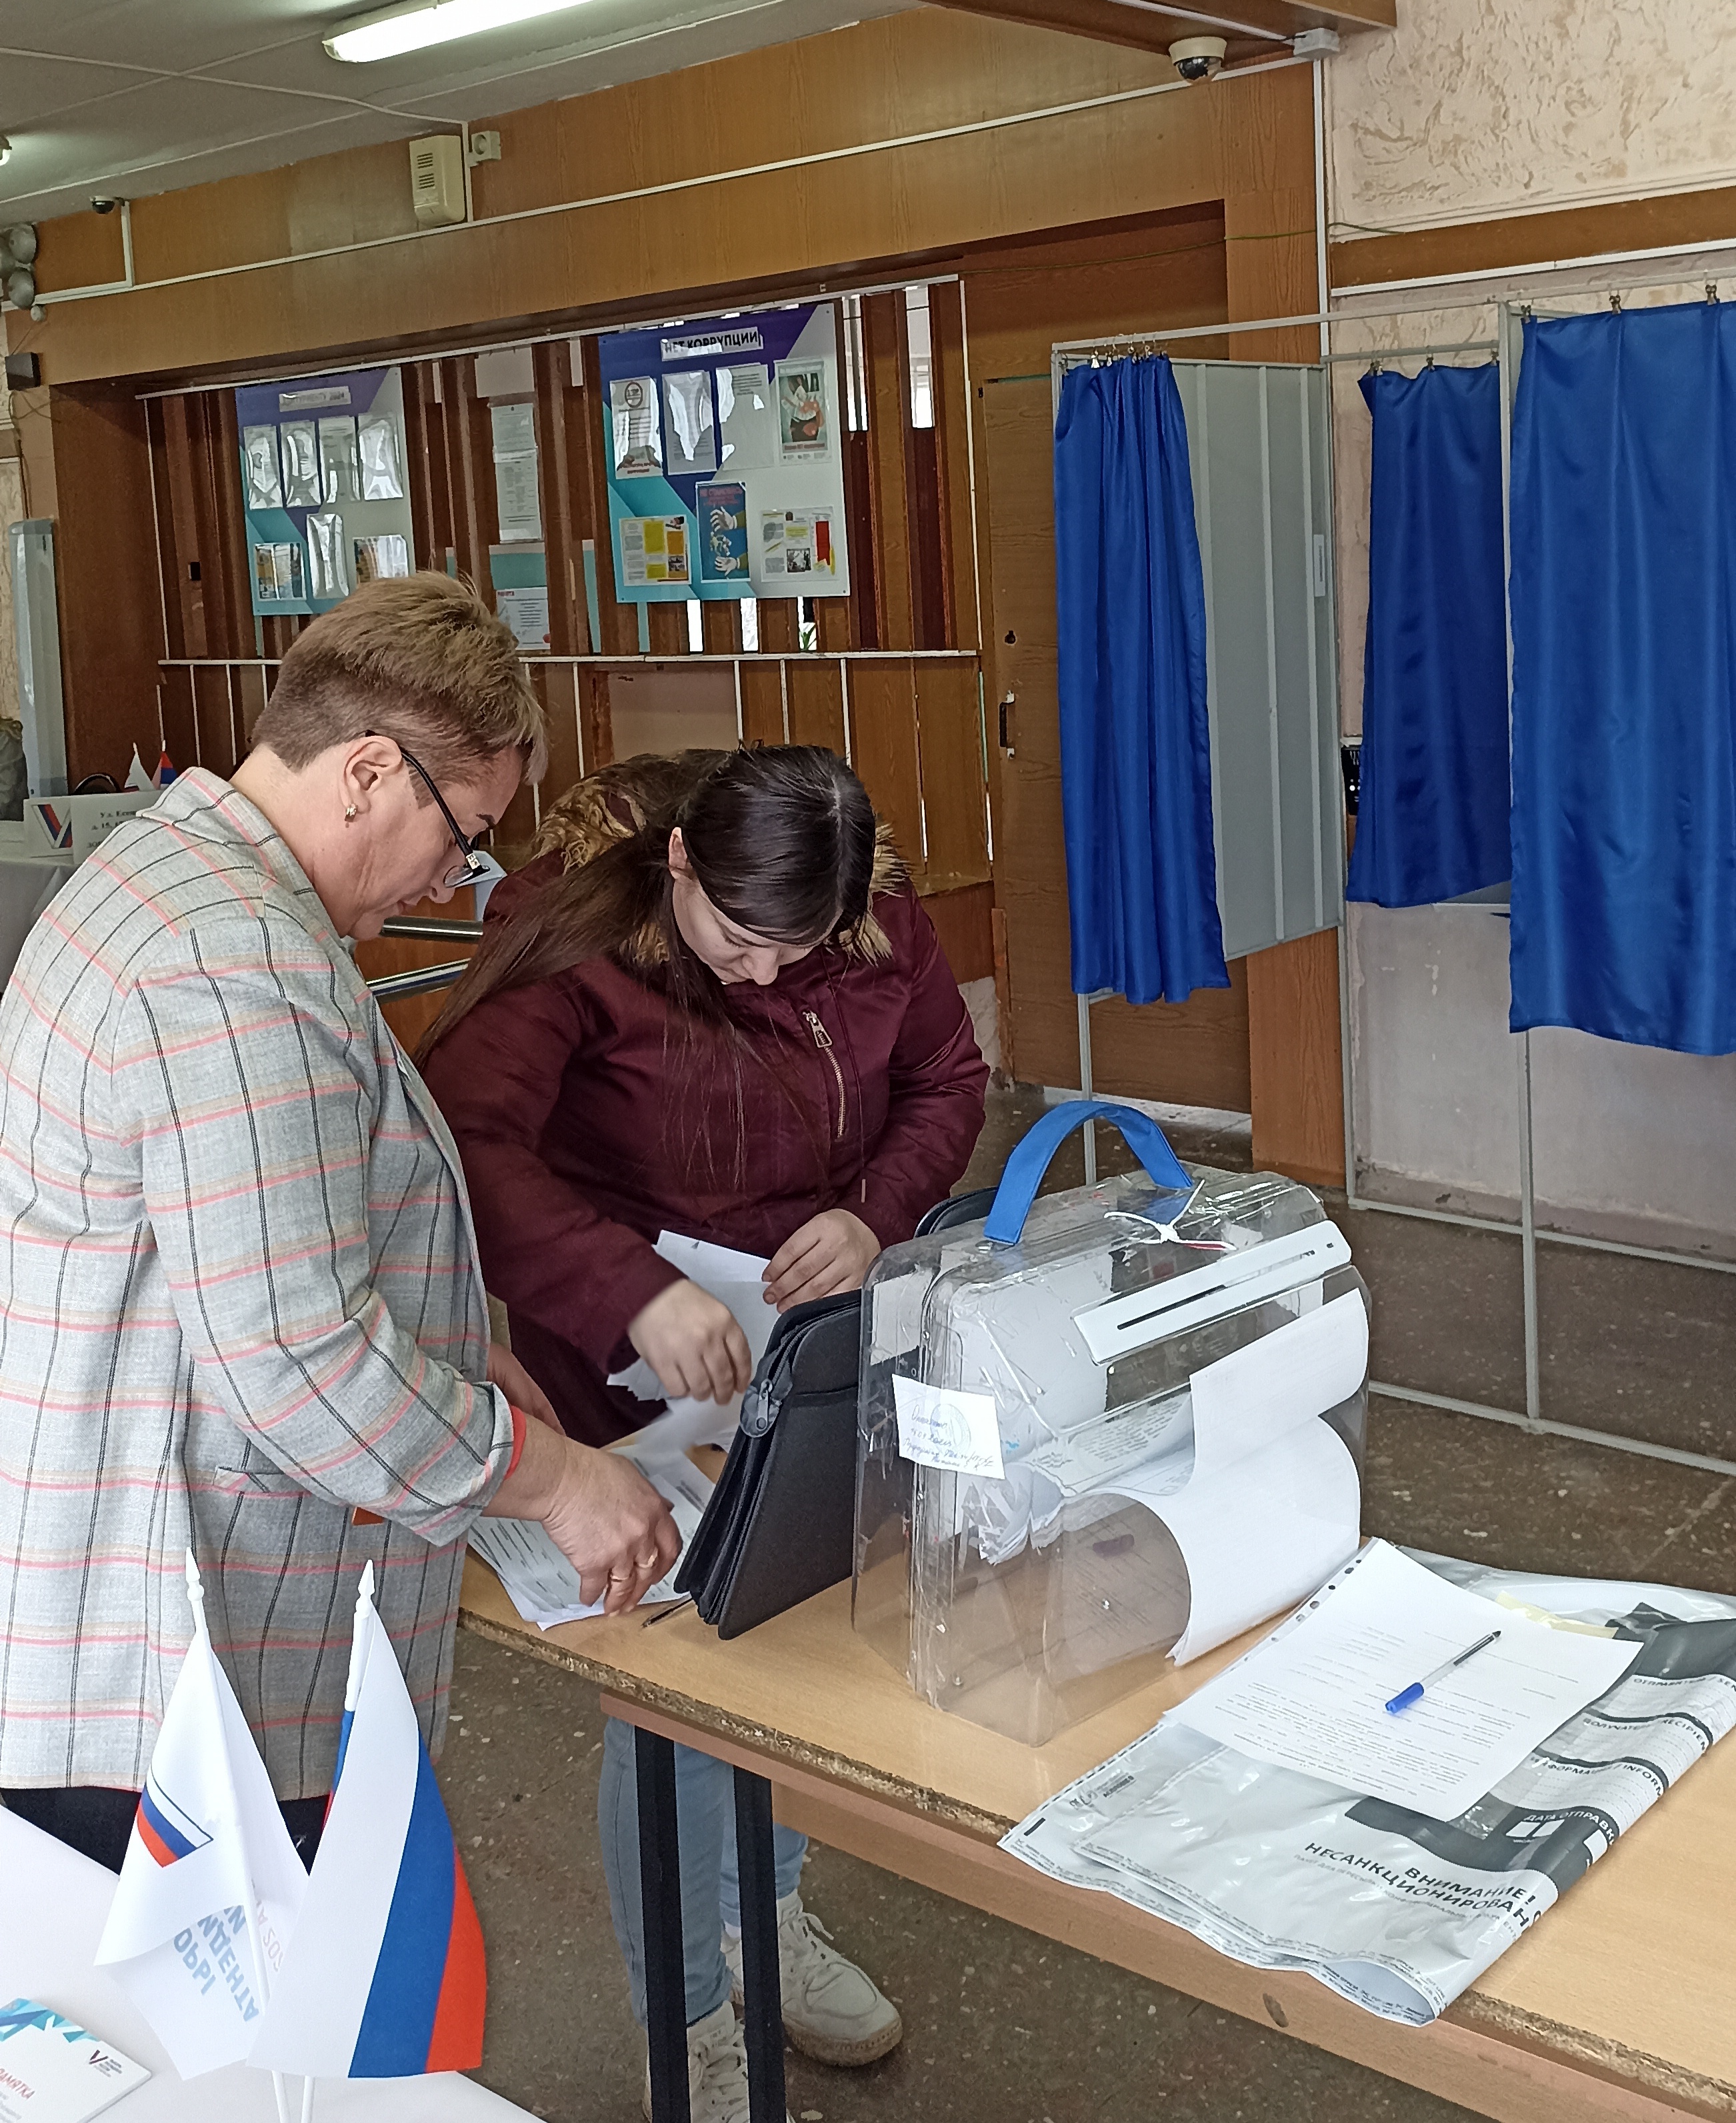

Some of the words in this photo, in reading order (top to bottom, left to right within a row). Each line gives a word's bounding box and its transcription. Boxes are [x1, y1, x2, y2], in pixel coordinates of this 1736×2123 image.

[1663, 1718, 1706, 1751] RECIPIEN
[1305, 1842, 1529, 1927] НЕСАНКЦИОНИРОВАН
[1405, 1867, 1536, 1905] ВНИМАНИЕ!
